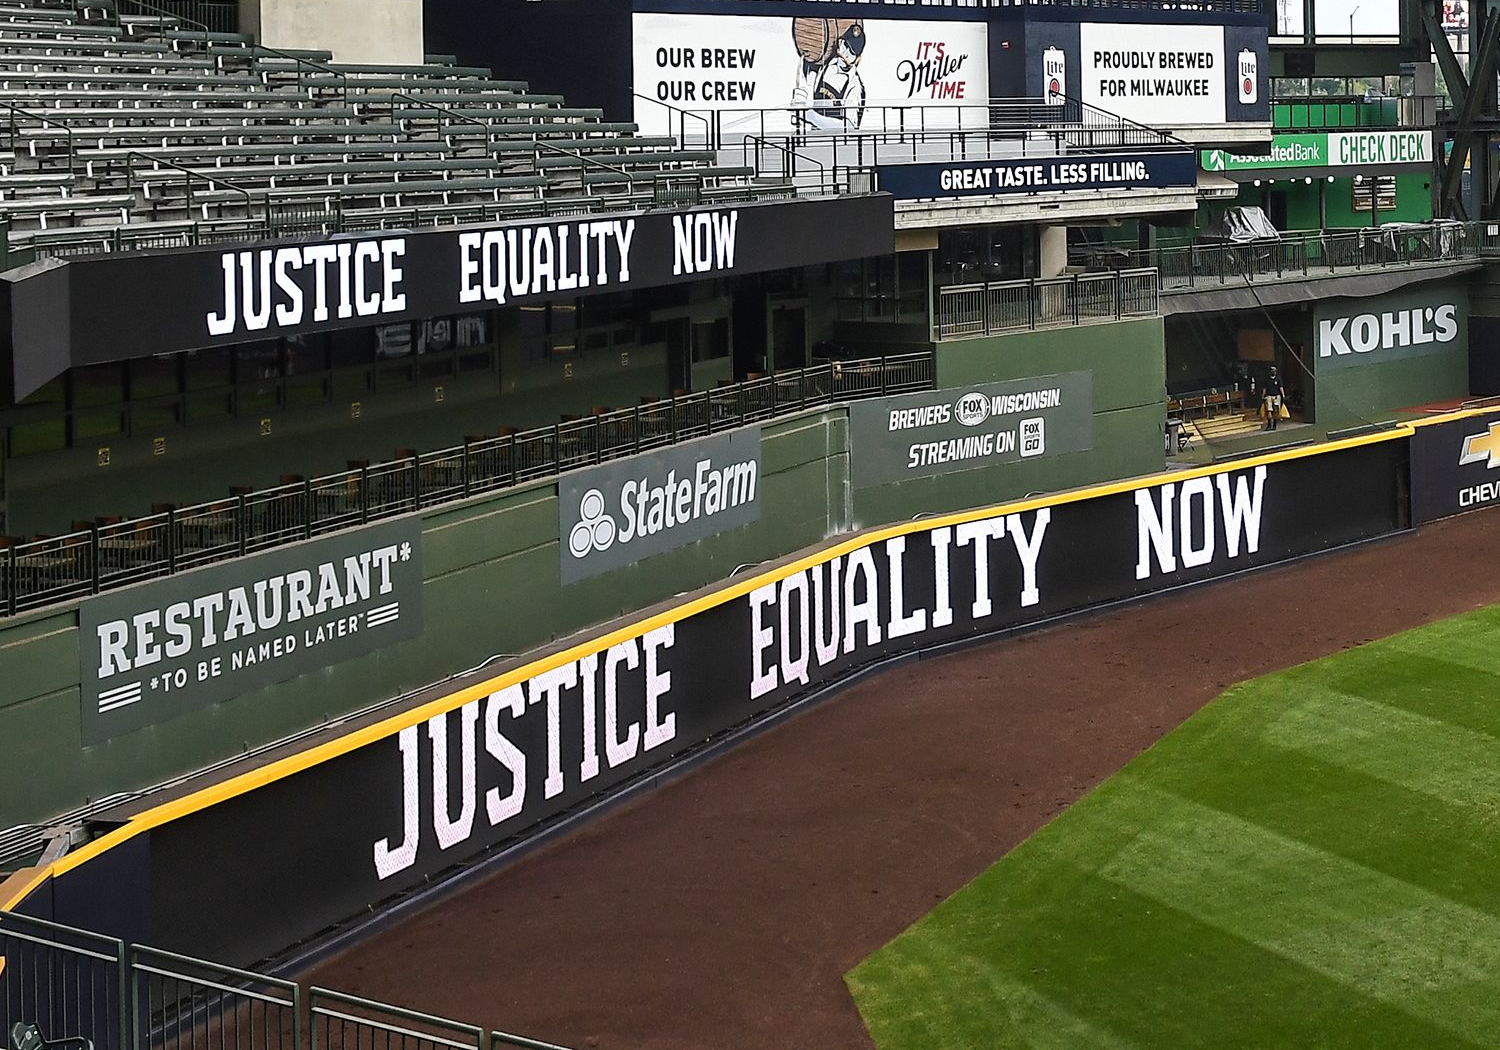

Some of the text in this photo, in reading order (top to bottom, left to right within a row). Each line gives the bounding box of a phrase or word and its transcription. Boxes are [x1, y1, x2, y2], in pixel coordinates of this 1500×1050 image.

[654, 46, 757, 70] OUR BREW
[915, 40, 946, 61] IT'S
[1093, 51, 1214, 69] PROUDLY BREWED
[896, 52, 969, 100] Miller
[1046, 60, 1064, 77] Lite
[1241, 61, 1256, 77] Lite
[655, 80, 757, 102] OUR CREW
[929, 80, 966, 100] TIME
[1100, 79, 1209, 97] FOR MILWAUKEE
[1339, 133, 1425, 164] CHECK DECK
[940, 161, 1150, 191] GREAT TASTE. LESS FILLING.
[205, 210, 739, 336] JUSTICE EQUALITY NOW
[1318, 303, 1459, 359] KOHL'S
[962, 412, 984, 421] SPORTS
[963, 398, 983, 413] FOX
[888, 403, 952, 432] BREWERS
[1024, 422, 1040, 435] FOX
[907, 429, 1016, 469] STREAMING ON
[1024, 438, 1040, 451] GO
[197, 657, 222, 682] BE
[231, 634, 297, 670] NAMED
[373, 466, 1267, 881] JUSTICE EQUALITY NOW
